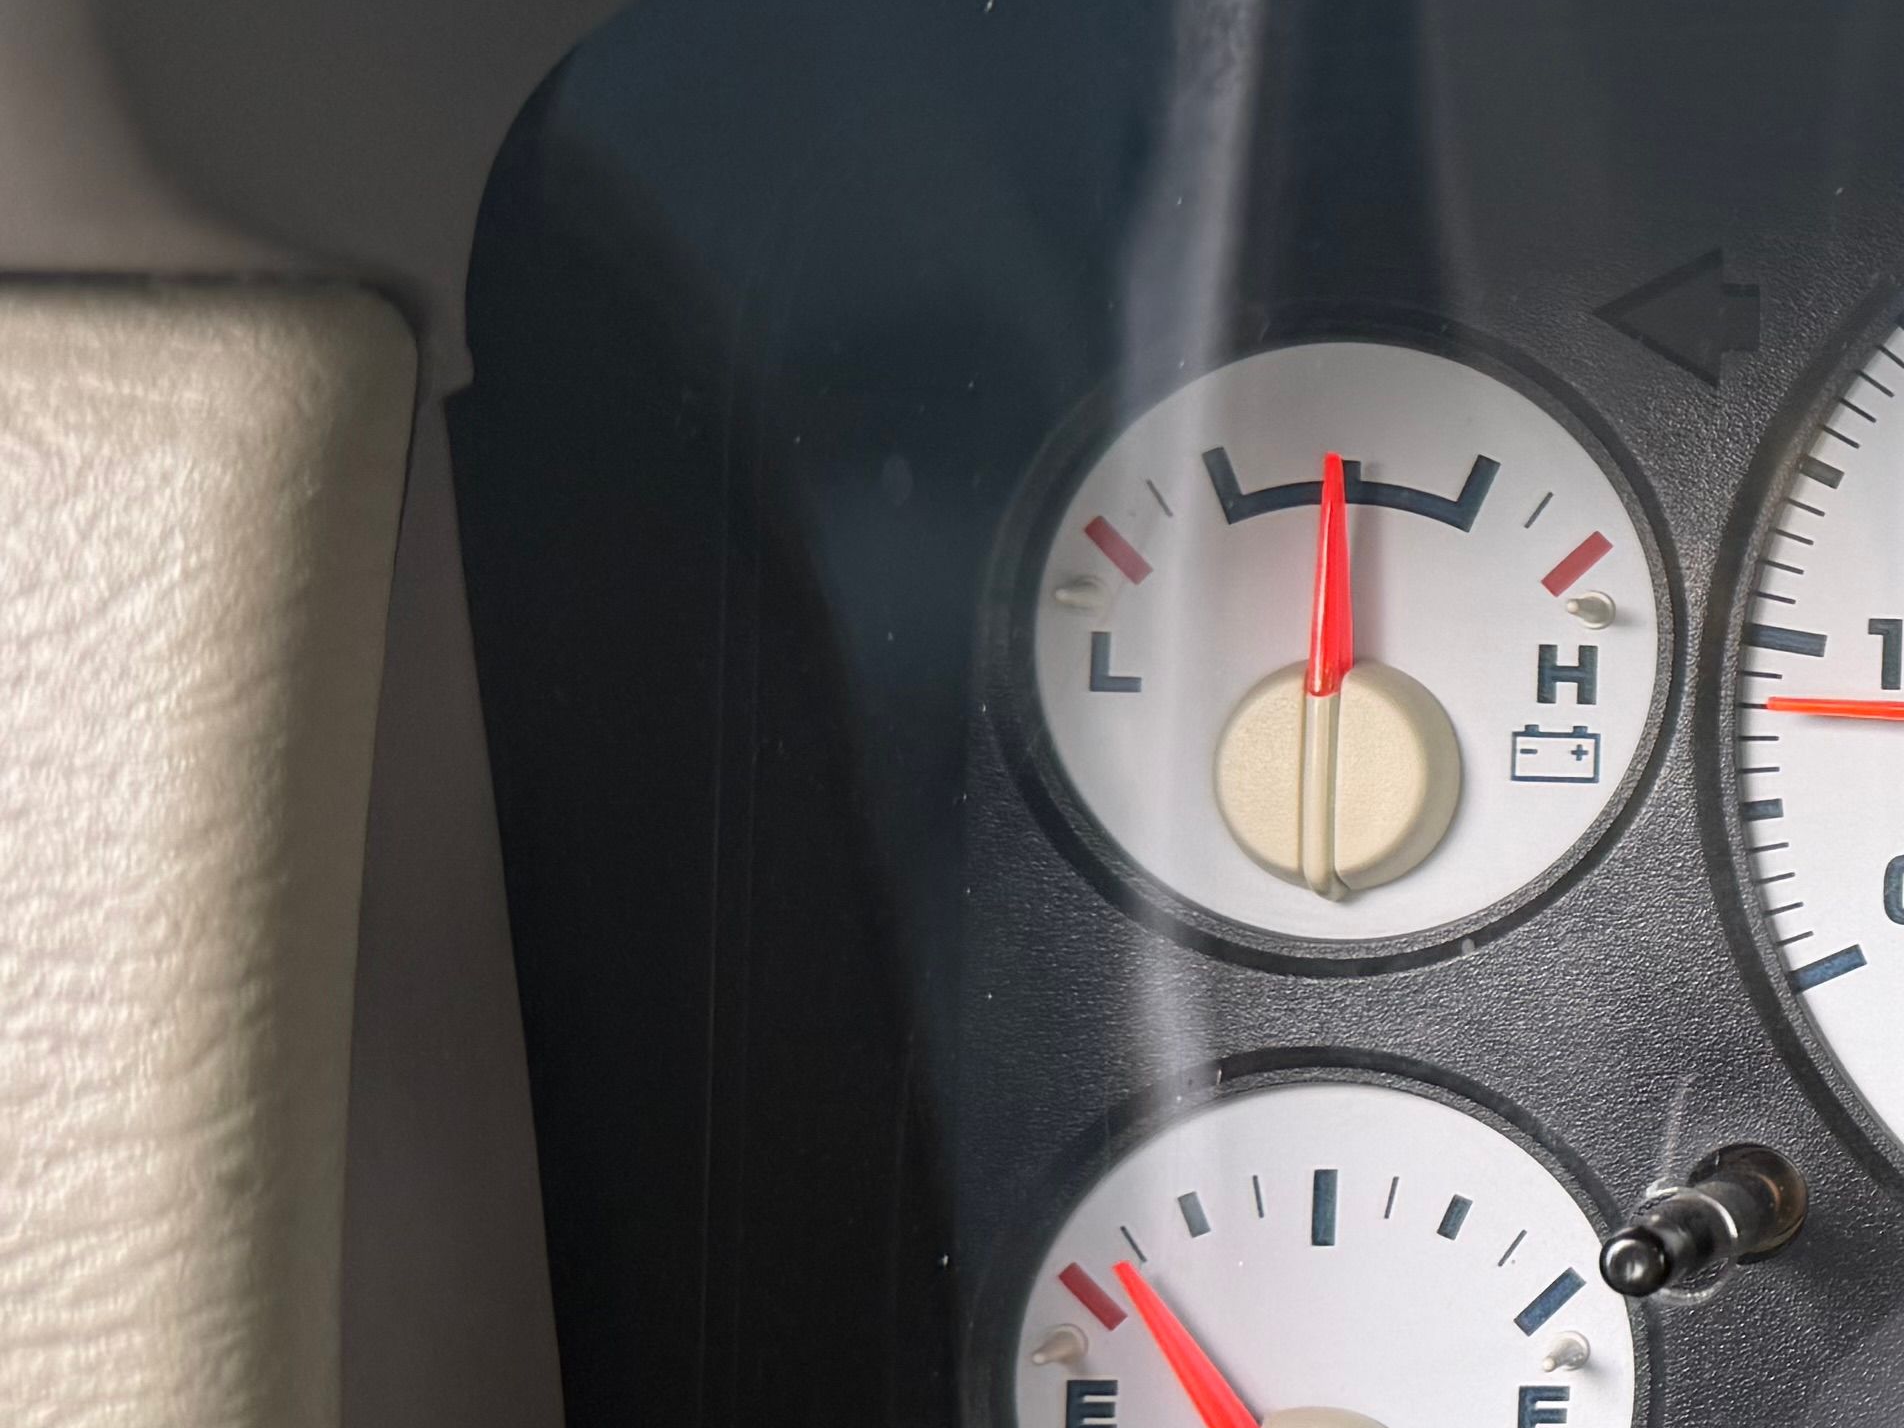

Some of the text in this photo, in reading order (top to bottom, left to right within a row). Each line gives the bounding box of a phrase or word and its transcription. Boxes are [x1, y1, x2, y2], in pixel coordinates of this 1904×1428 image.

[1088, 631, 1141, 692] L
[1537, 644, 1597, 705] H
[1868, 619, 1902, 690] 1
